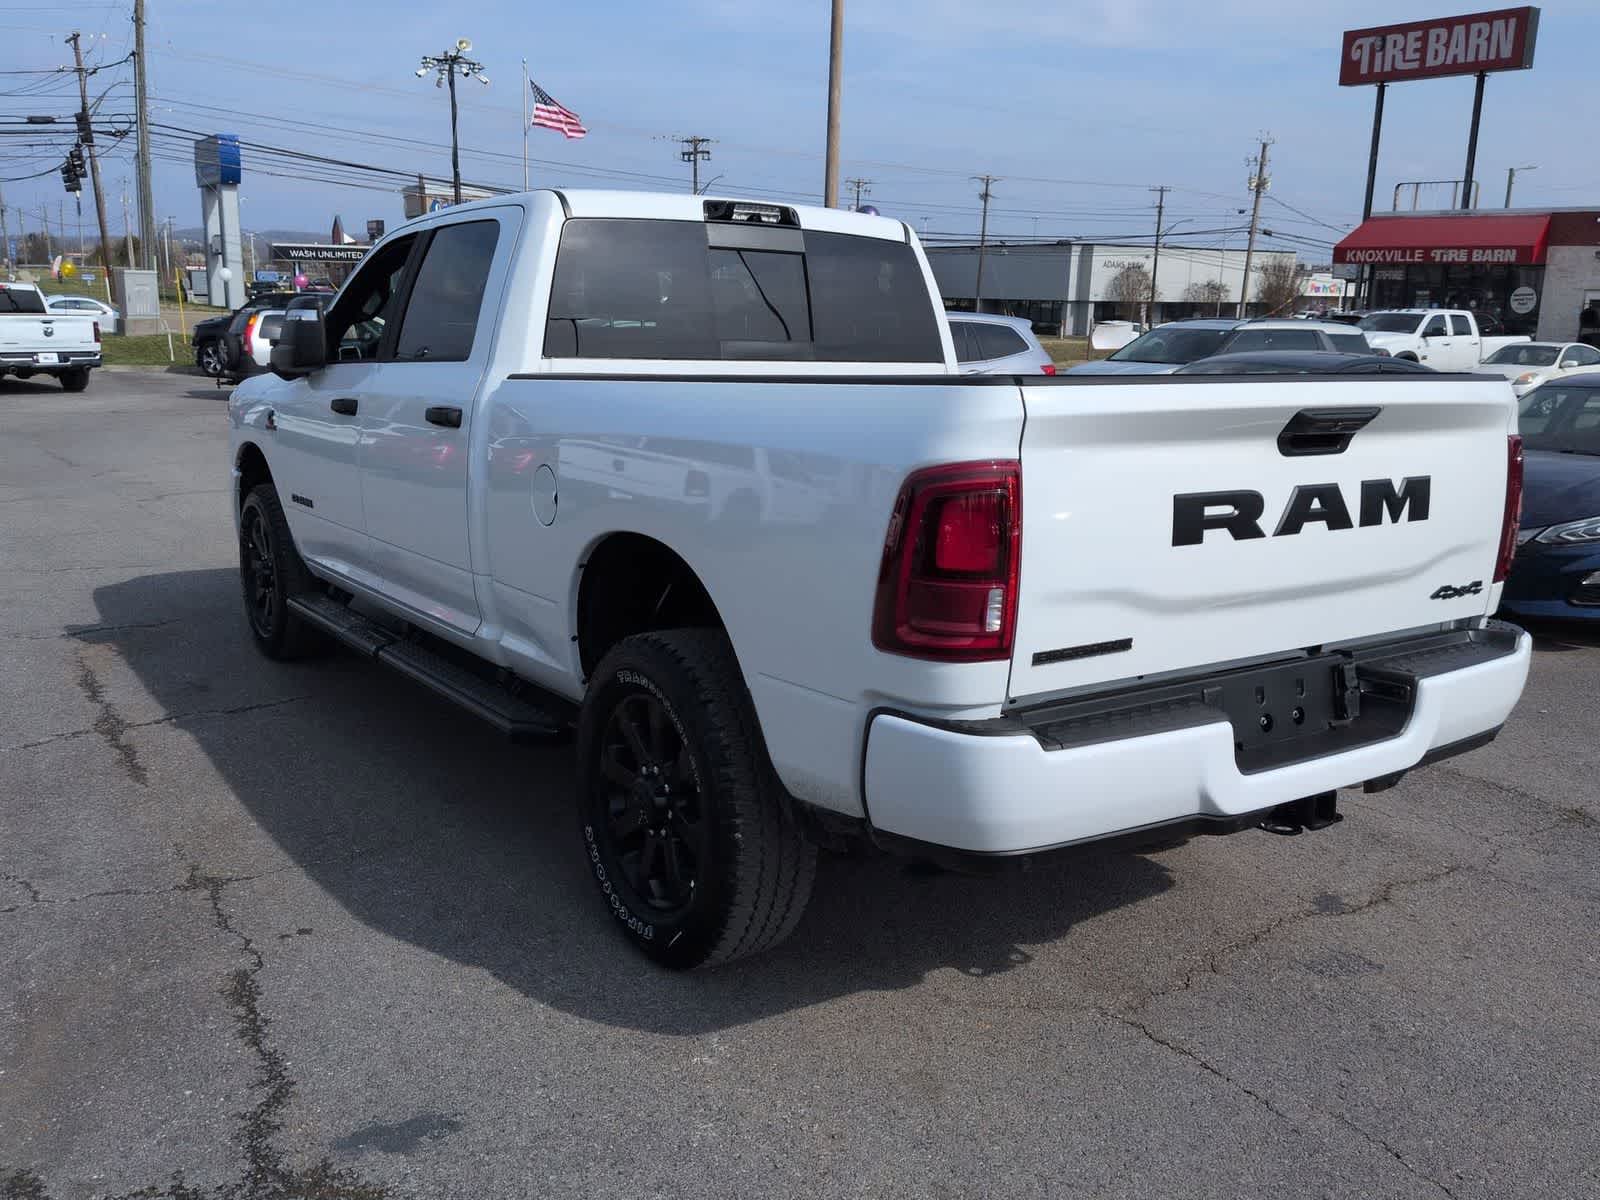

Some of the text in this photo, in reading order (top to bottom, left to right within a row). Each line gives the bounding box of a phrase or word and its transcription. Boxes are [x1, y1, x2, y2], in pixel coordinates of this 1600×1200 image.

[1425, 17, 1517, 67] BARN
[289, 249, 364, 259] WASH UNLIMITED
[1345, 249, 1424, 263] KNOXVILLE
[1471, 249, 1517, 263] BARN
[1171, 474, 1432, 547] RAM
